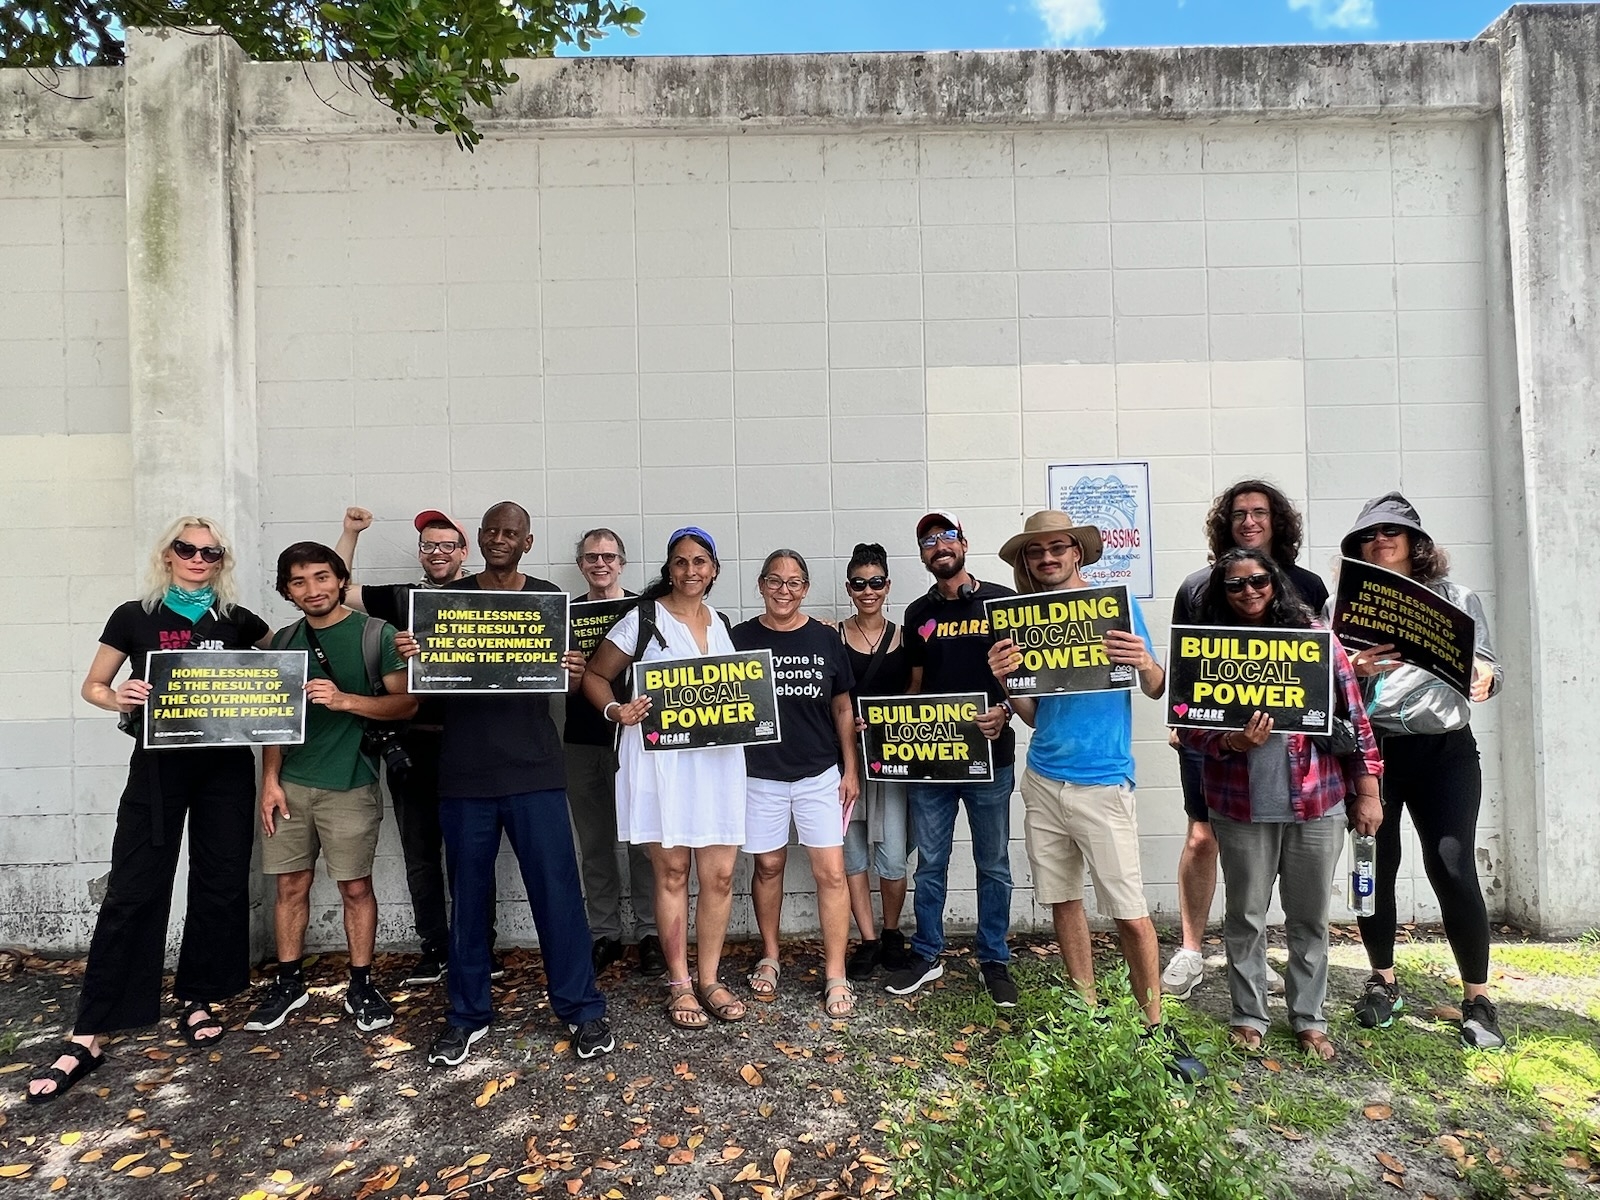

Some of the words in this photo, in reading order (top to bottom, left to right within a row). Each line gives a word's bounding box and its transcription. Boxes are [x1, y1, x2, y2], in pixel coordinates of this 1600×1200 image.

[1102, 529, 1140, 548] PASSING
[1080, 570, 1131, 579] 05-416-0202
[992, 596, 1120, 630] BUILDING
[1362, 580, 1453, 628] HOMELESSNESS
[437, 610, 541, 621] HOMELESSNESS
[1358, 592, 1371, 602] IS
[1373, 595, 1398, 610] THE
[1399, 604, 1441, 632] RESULT
[1442, 628, 1456, 640] OF
[434, 624, 448, 634] IS
[450, 624, 476, 634] THE
[478, 624, 527, 634] RESULT
[528, 625, 546, 634] OF
[936, 619, 990, 637] MCARE
[1010, 621, 1103, 649] LOCAL
[1350, 602, 1377, 616] THE
[1378, 609, 1461, 658] GOVERNMENT
[426, 637, 454, 648] THE
[456, 638, 553, 648] GOVERNMENT
[1180, 636, 1320, 663] BUILDING
[1342, 612, 1395, 634] FAILING
[1398, 627, 1422, 645] THE
[1423, 638, 1465, 673] PEOPLE
[420, 652, 475, 663] FAILING
[477, 652, 504, 662] THE
[506, 652, 557, 663] PEOPLE
[813, 654, 824, 665] is
[172, 669, 278, 678] HOMELESSNESS
[645, 660, 763, 690] BUILDING
[774, 668, 823, 680] eone's
[1200, 659, 1300, 684] LOCAL
[168, 682, 181, 691] IS
[183, 681, 210, 691] THE
[212, 681, 263, 690] RESULT
[265, 681, 283, 690] OF
[776, 683, 823, 698] ebody.
[1006, 676, 1036, 687] MCARE
[159, 695, 187, 705] THE
[190, 693, 290, 704] GOVERNMENT
[664, 681, 750, 708] LOCAL
[1193, 682, 1305, 708] POWER
[154, 708, 208, 719] FAILING
[210, 708, 238, 718] THE
[241, 707, 294, 717] PEOPLE
[661, 702, 755, 730] POWER
[868, 703, 978, 724] BUILDING
[1188, 708, 1225, 719] MCARE
[660, 732, 690, 743] MCARE
[885, 722, 964, 742] LOCAL
[882, 742, 969, 761] POWER
[882, 765, 908, 774] MCARE
[1358, 860, 1368, 892] smart
